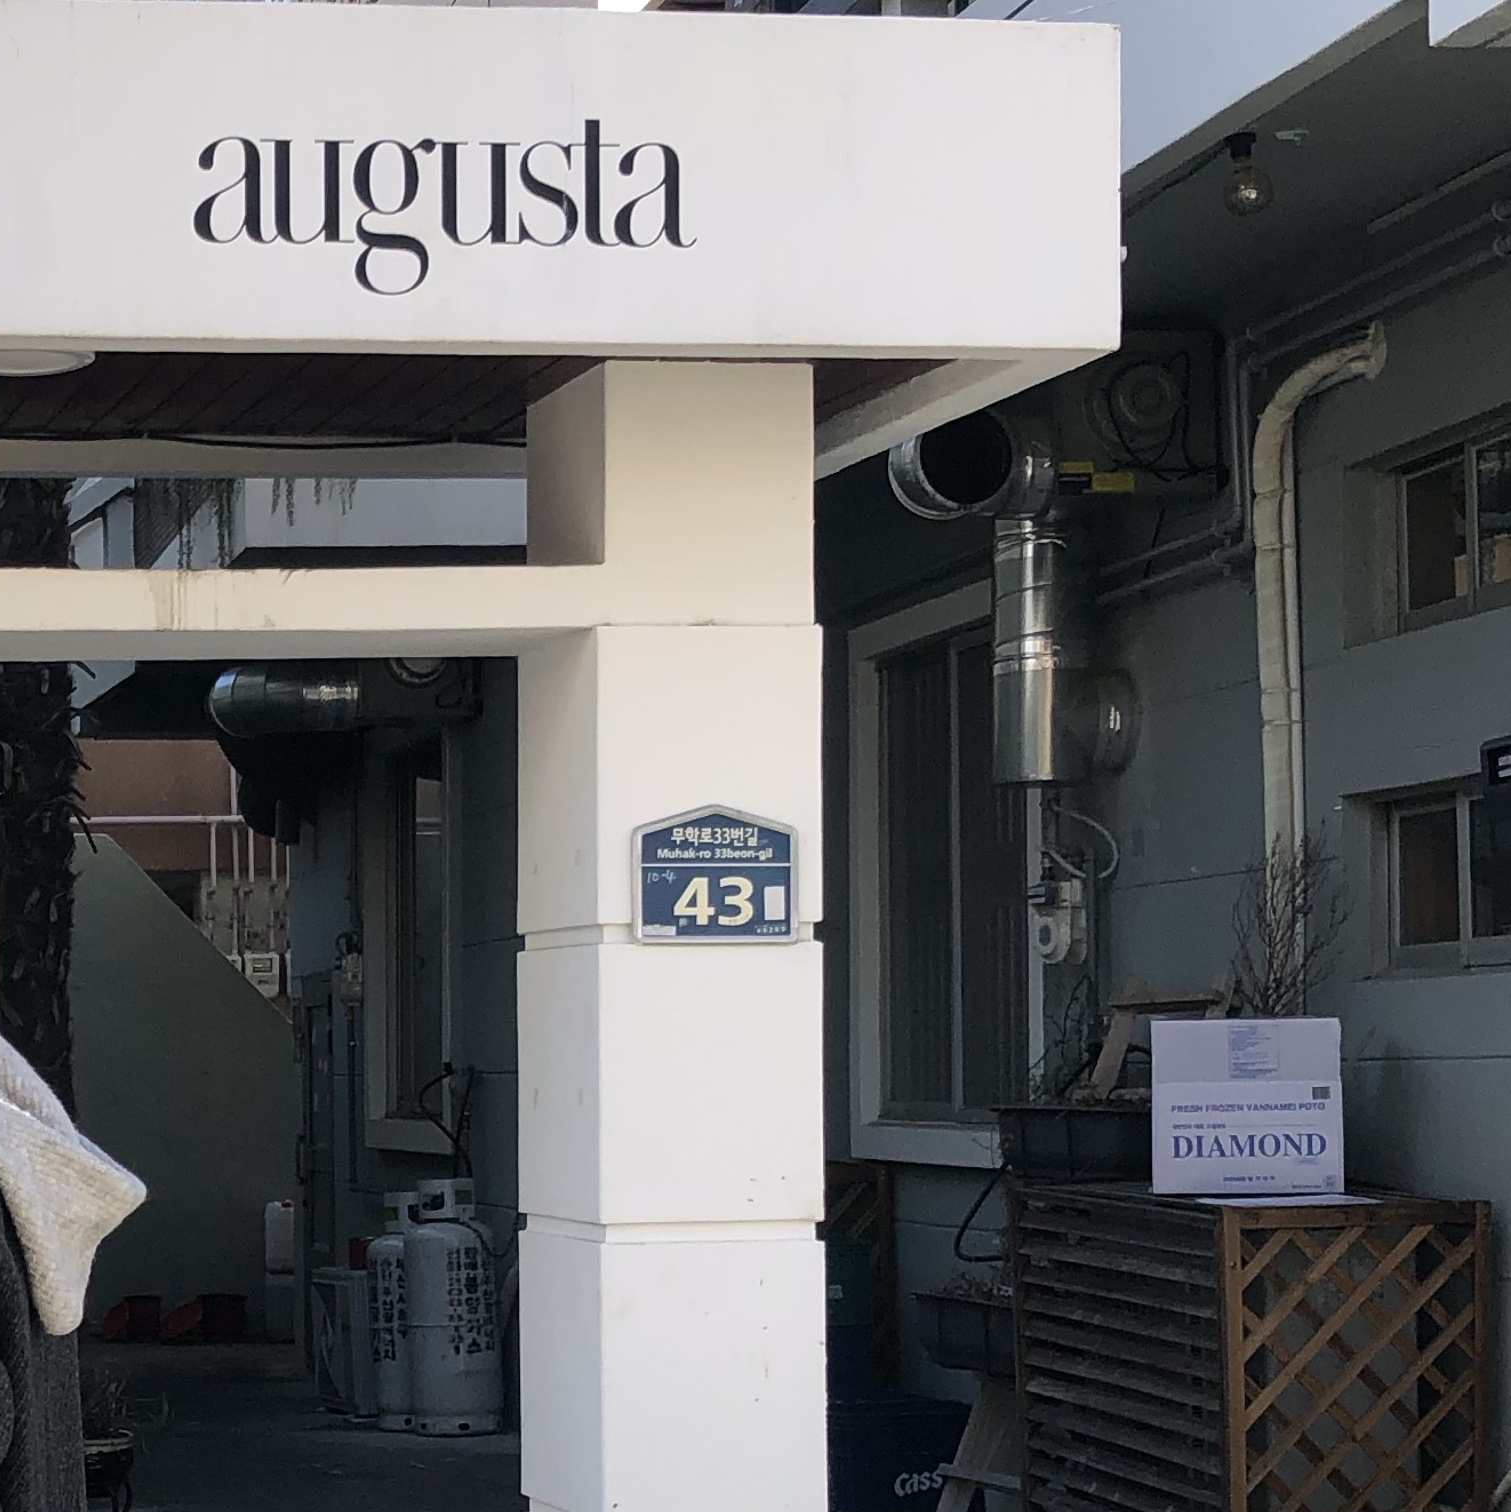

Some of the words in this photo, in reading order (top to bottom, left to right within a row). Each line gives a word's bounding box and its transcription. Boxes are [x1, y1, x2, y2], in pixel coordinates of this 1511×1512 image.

[192, 119, 697, 296] augusta
[671, 827, 758, 846] 무학로33번길
[656, 848, 712, 859] Muhak-ro
[714, 848, 773, 861] 33beon-gil
[673, 876, 754, 926] 43
[1171, 1104, 1203, 1113] FRESH
[1205, 1103, 1244, 1112] FROZEN
[1172, 1133, 1327, 1158] DIAMOND
